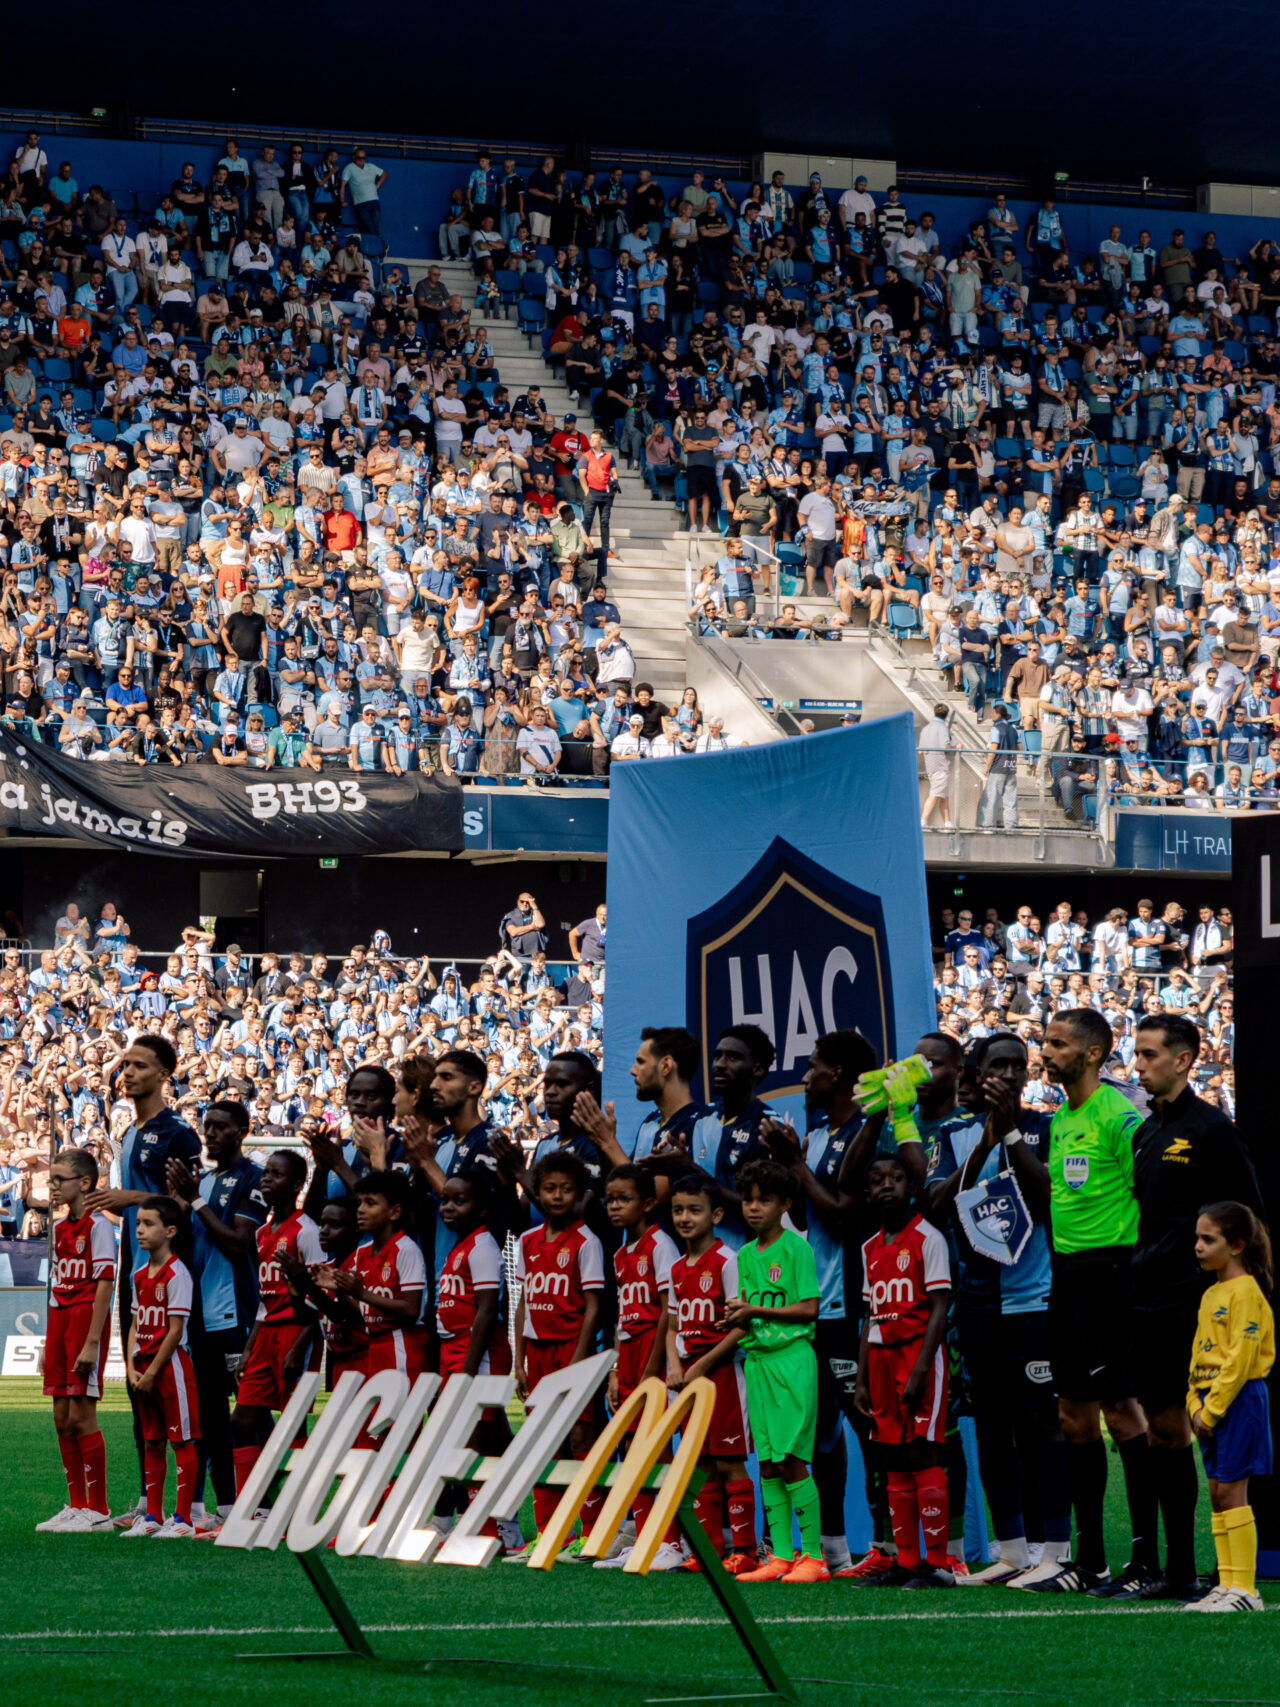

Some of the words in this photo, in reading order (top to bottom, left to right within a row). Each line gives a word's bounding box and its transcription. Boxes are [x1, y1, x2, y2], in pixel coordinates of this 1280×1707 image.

[40, 783, 189, 846] jamais
[245, 780, 367, 818] BH93
[1164, 829, 1189, 855] LH
[1193, 836, 1232, 856] TRAI
[728, 946, 858, 1072] HAC
[1066, 1157, 1087, 1167] FIFA
[977, 1198, 1009, 1219] HAC
[214, 1369, 518, 1564] LIGUE
